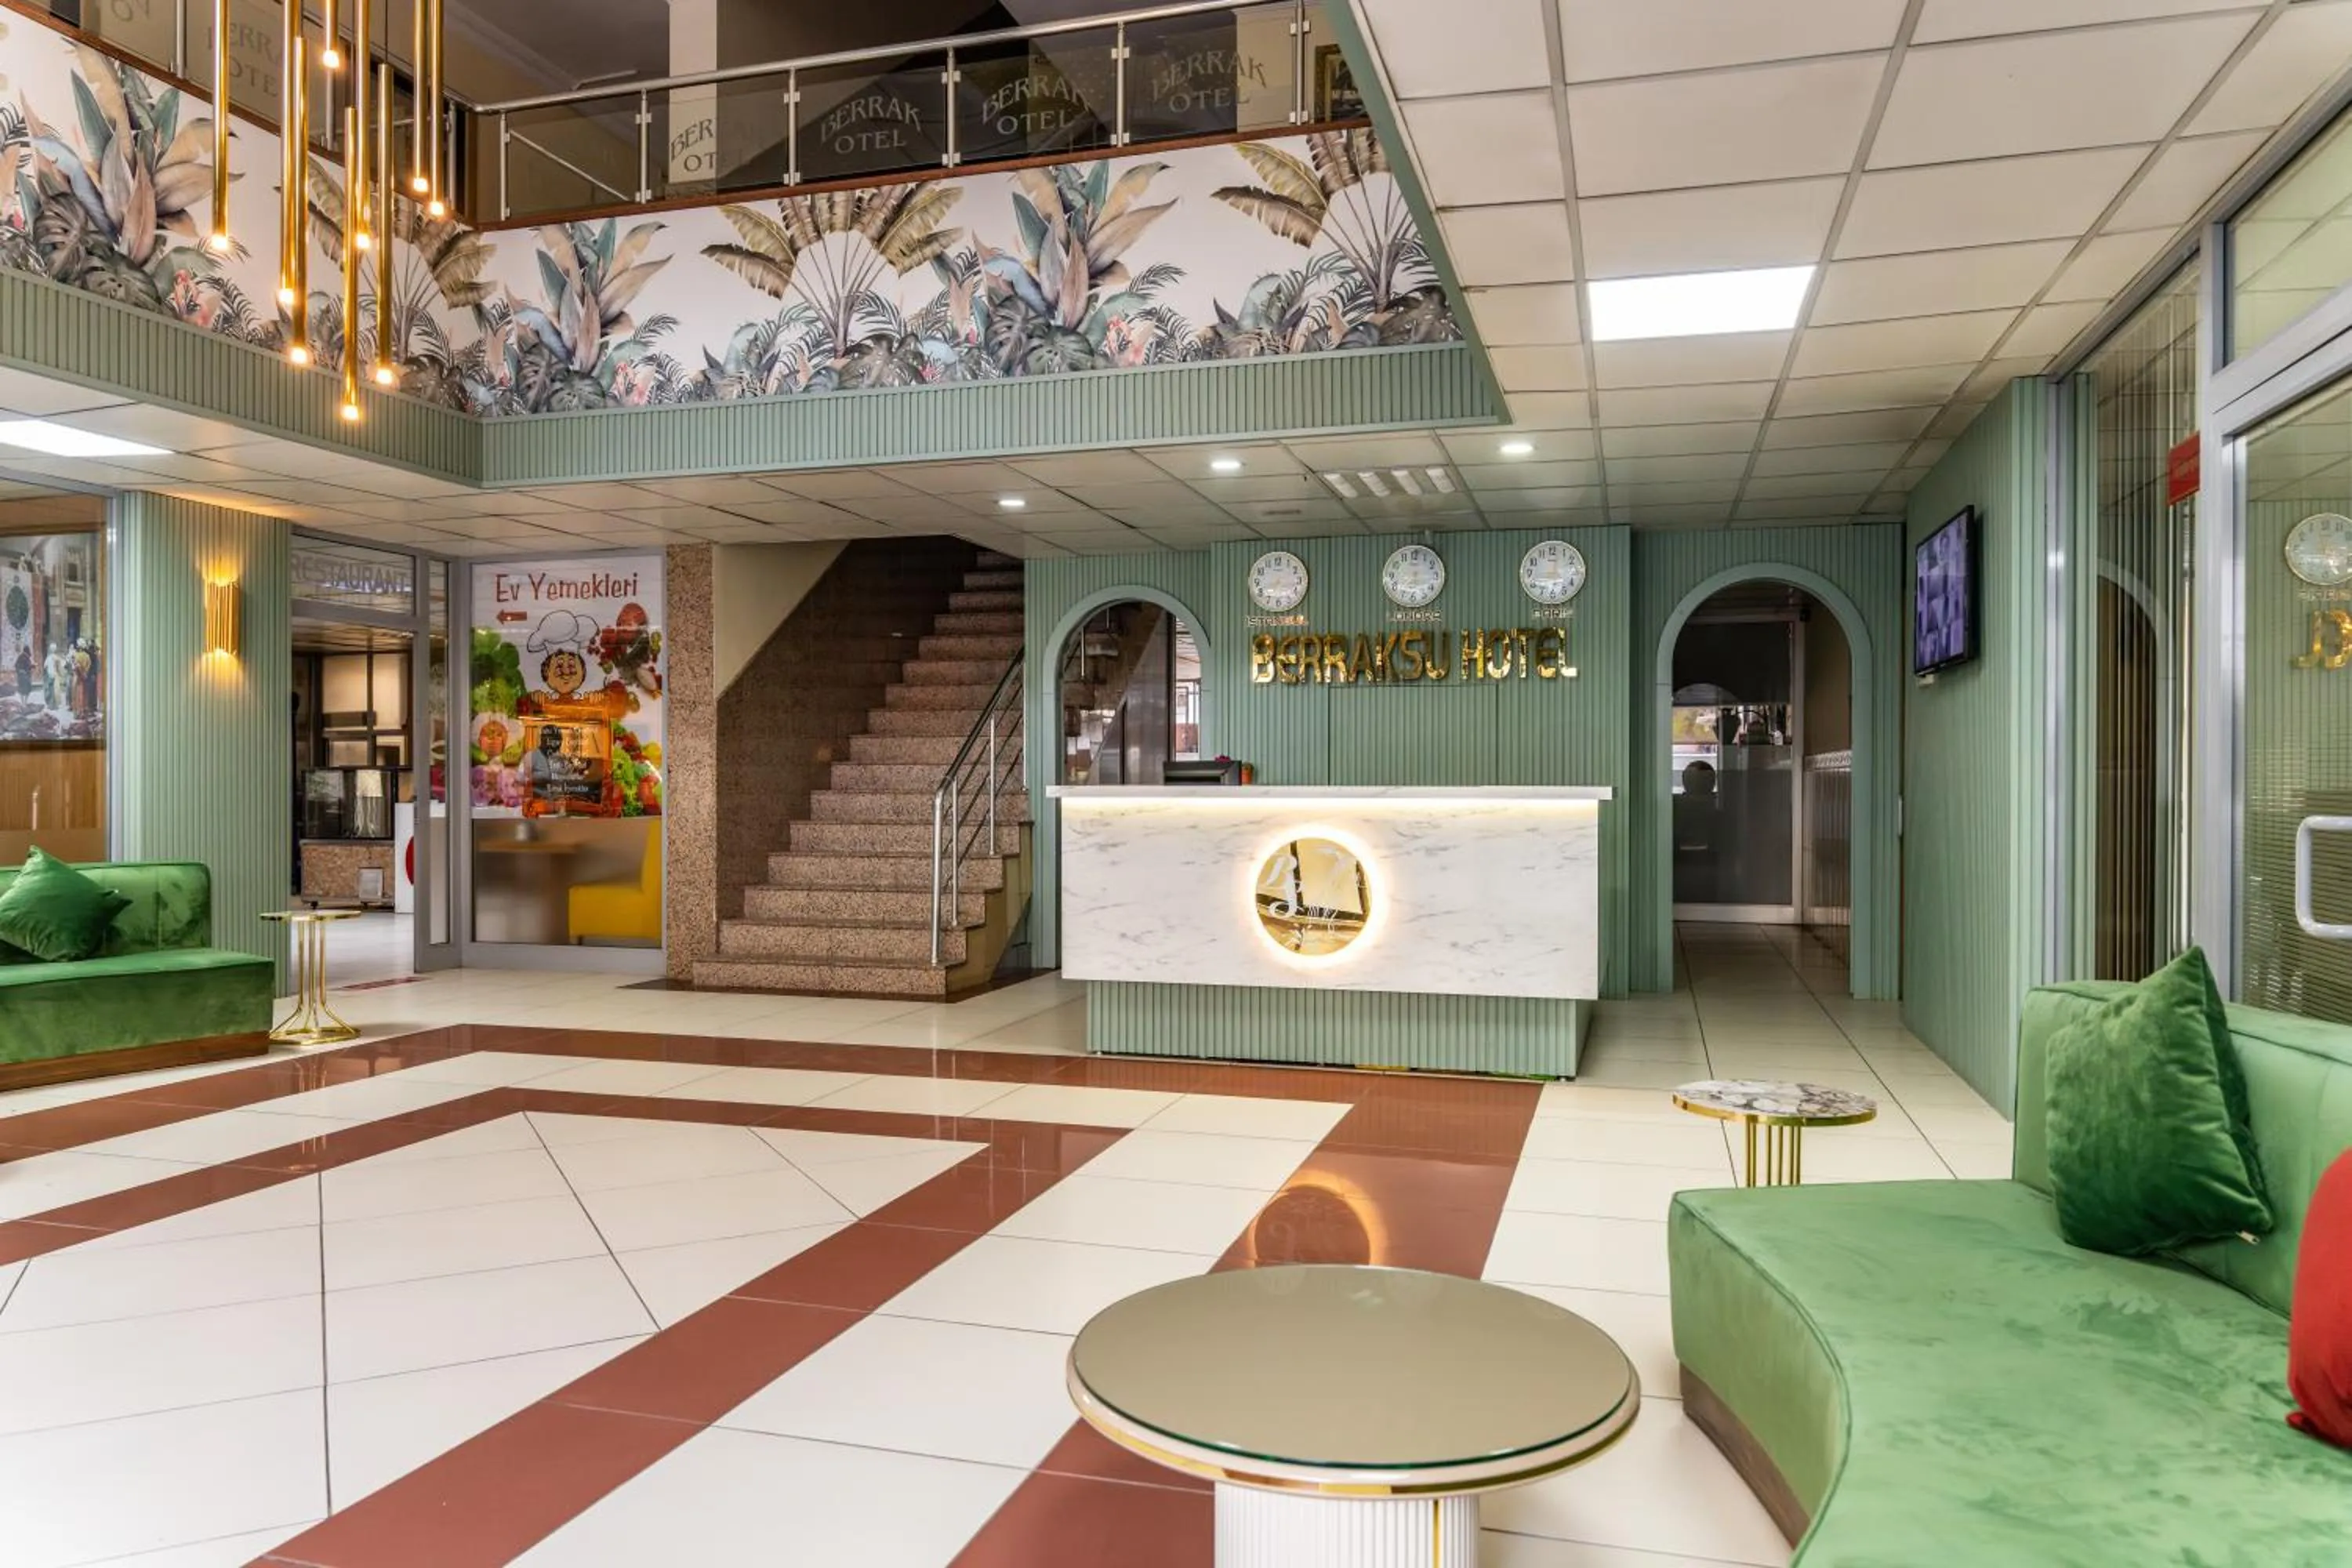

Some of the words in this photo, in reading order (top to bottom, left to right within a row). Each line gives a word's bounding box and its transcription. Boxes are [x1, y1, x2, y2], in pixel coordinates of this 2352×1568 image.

[229, 56, 278, 96] OTE
[1152, 49, 1266, 101] BERRAK
[982, 76, 1092, 123] BERRAK
[1169, 83, 1250, 113] OTEL
[822, 96, 920, 144] BERRAK
[996, 110, 1076, 136] OTEL
[835, 129, 907, 154] OTEL
[290, 554, 410, 597] RESTAURANT
[496, 574, 520, 602] Ev
[528, 572, 638, 601] Yemekleri
[1251, 630, 1451, 684] BERRAKSU
[1461, 627, 1578, 680] HOTEL
